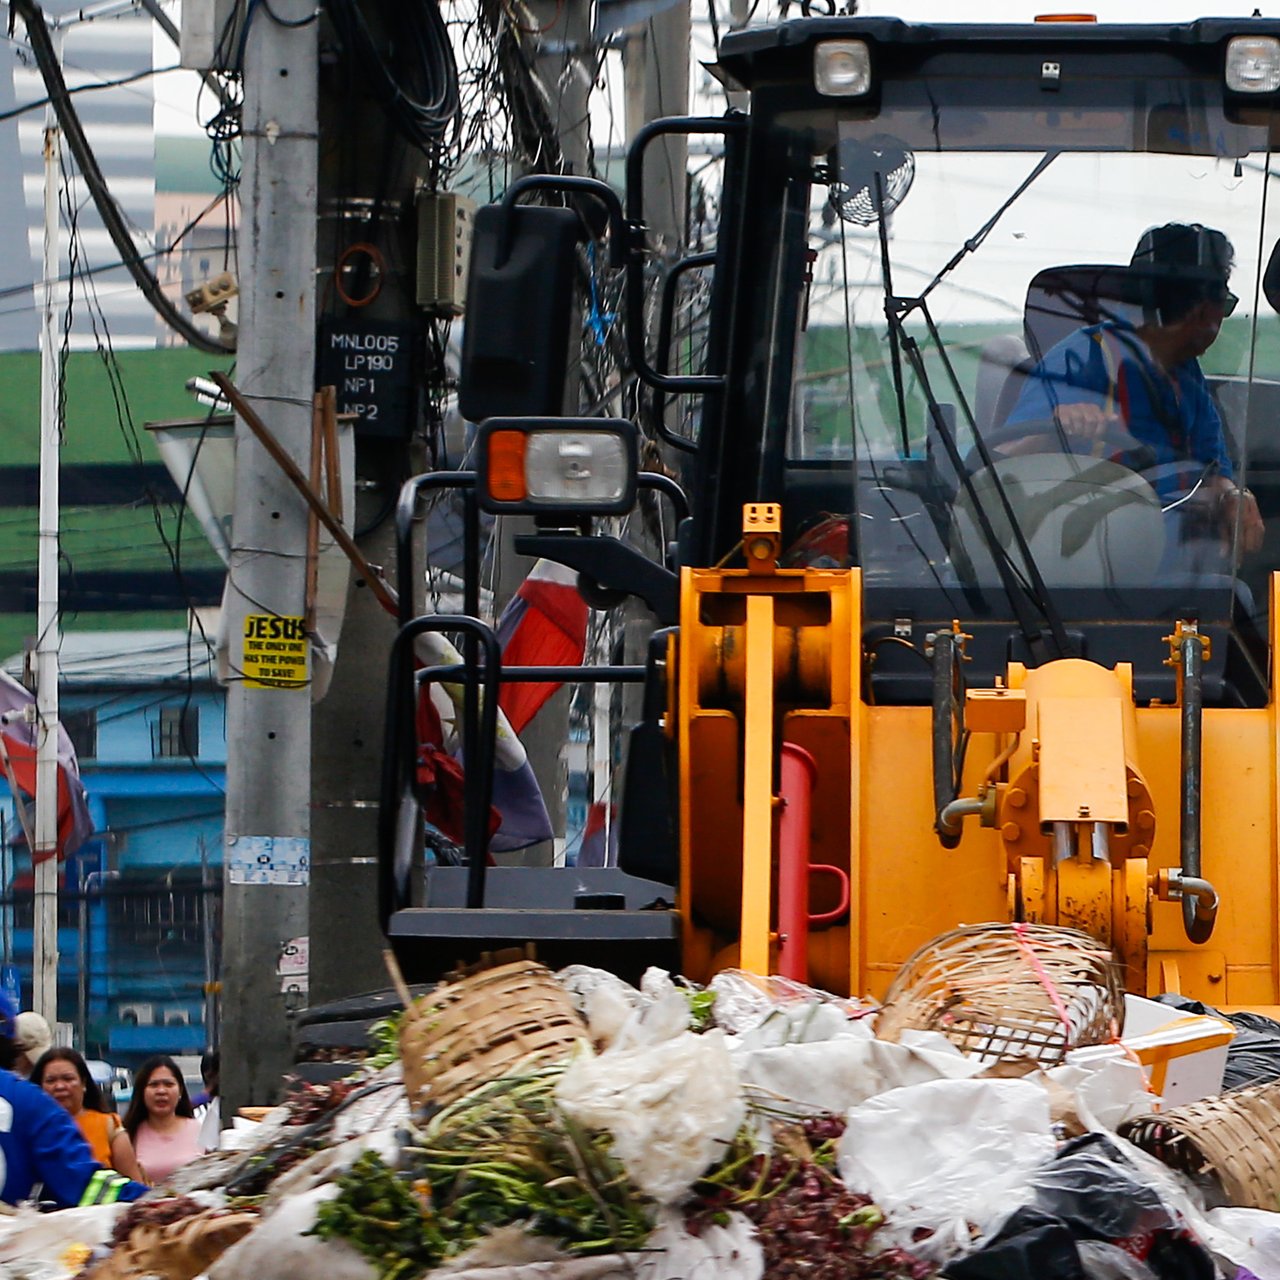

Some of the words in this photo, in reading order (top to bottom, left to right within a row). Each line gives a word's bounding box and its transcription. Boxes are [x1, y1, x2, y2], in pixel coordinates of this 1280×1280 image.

[331, 333, 400, 351] MNL005
[344, 354, 394, 371] LP190
[244, 616, 305, 640] JESUS
[248, 640, 264, 650] THE
[265, 641, 287, 652] ONLY
[260, 655, 278, 665] THE
